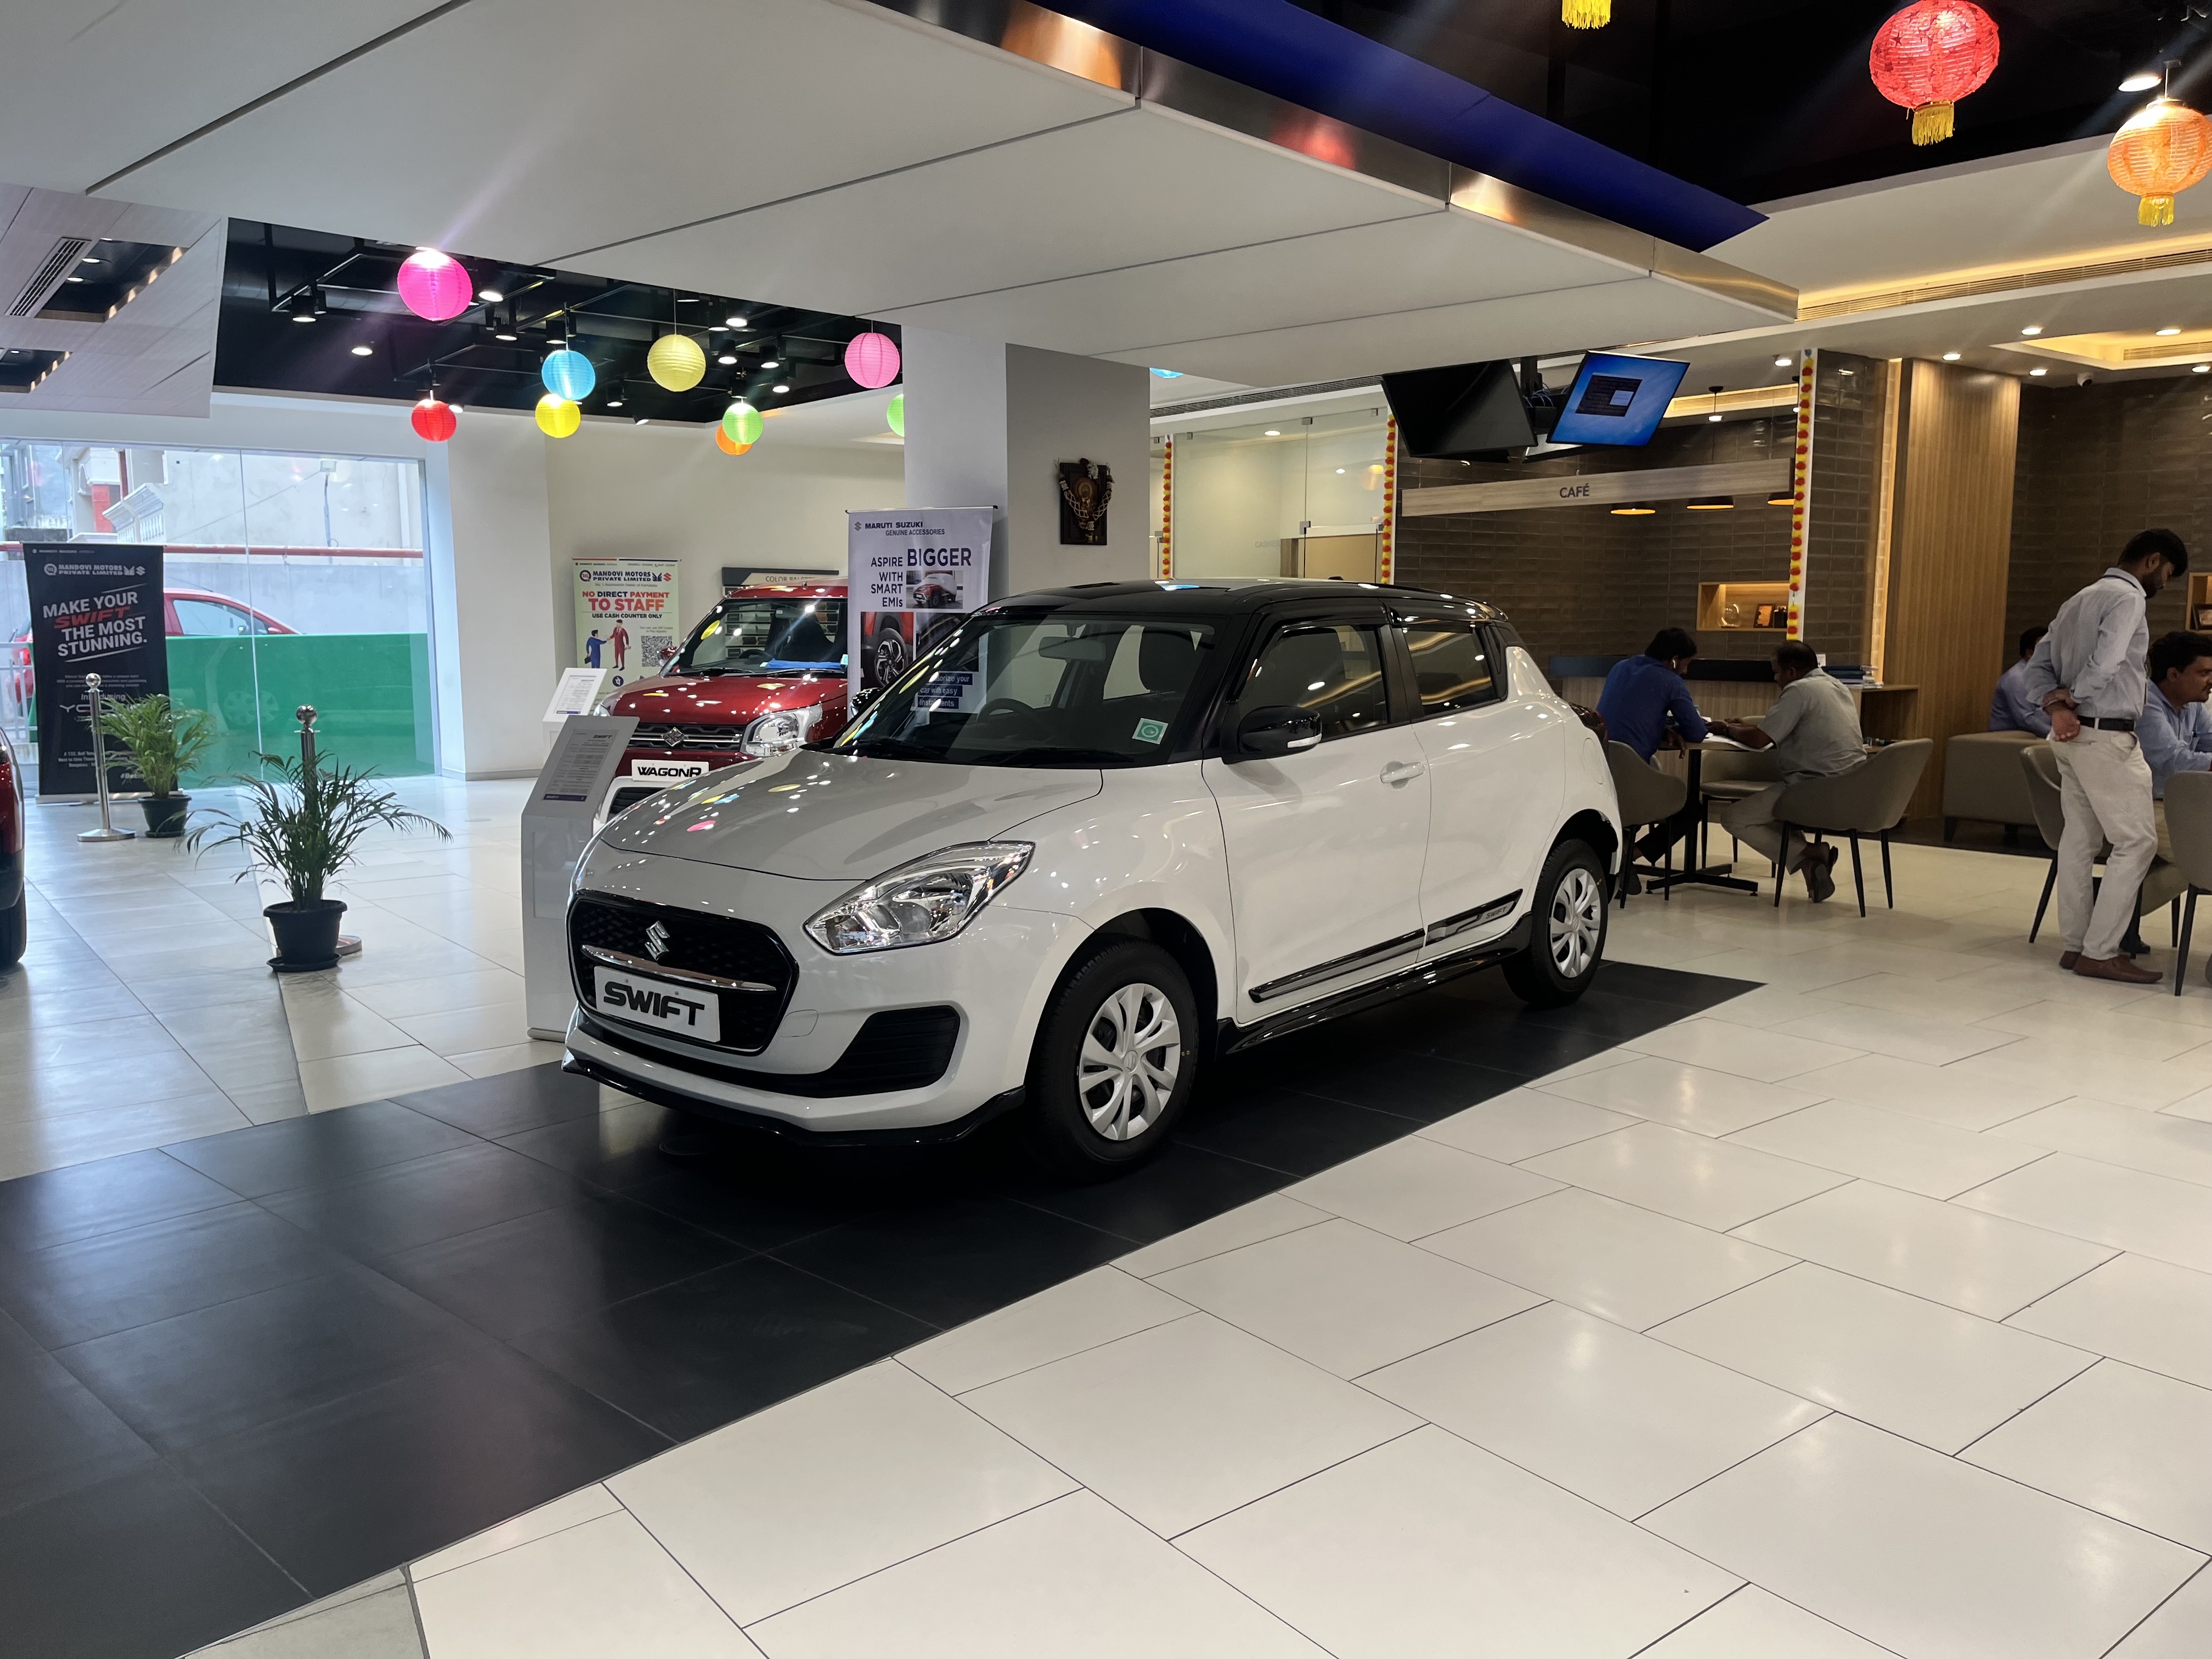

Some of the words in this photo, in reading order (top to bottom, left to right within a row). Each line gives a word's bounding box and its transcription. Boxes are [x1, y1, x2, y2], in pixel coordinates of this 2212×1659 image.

[1560, 483, 1589, 498] CAFÉ
[871, 557, 903, 567] ASPIRE
[907, 548, 972, 566] BIGGER
[879, 572, 903, 582] WITH
[871, 584, 903, 594] SMART
[43, 599, 91, 618] MAKE
[93, 591, 138, 609] YOUR
[588, 598, 611, 611] TO
[614, 599, 665, 611] STAFF
[883, 597, 903, 607] EMIs
[54, 606, 131, 629] SWIFT
[61, 624, 95, 641] THE
[98, 616, 145, 635] MOST
[58, 631, 147, 657] STUNNING.
[932, 685, 941, 694] with
[943, 688, 958, 696] easy
[1486, 906, 1507, 919] SWIFT
[603, 981, 705, 1026] SWIFT
